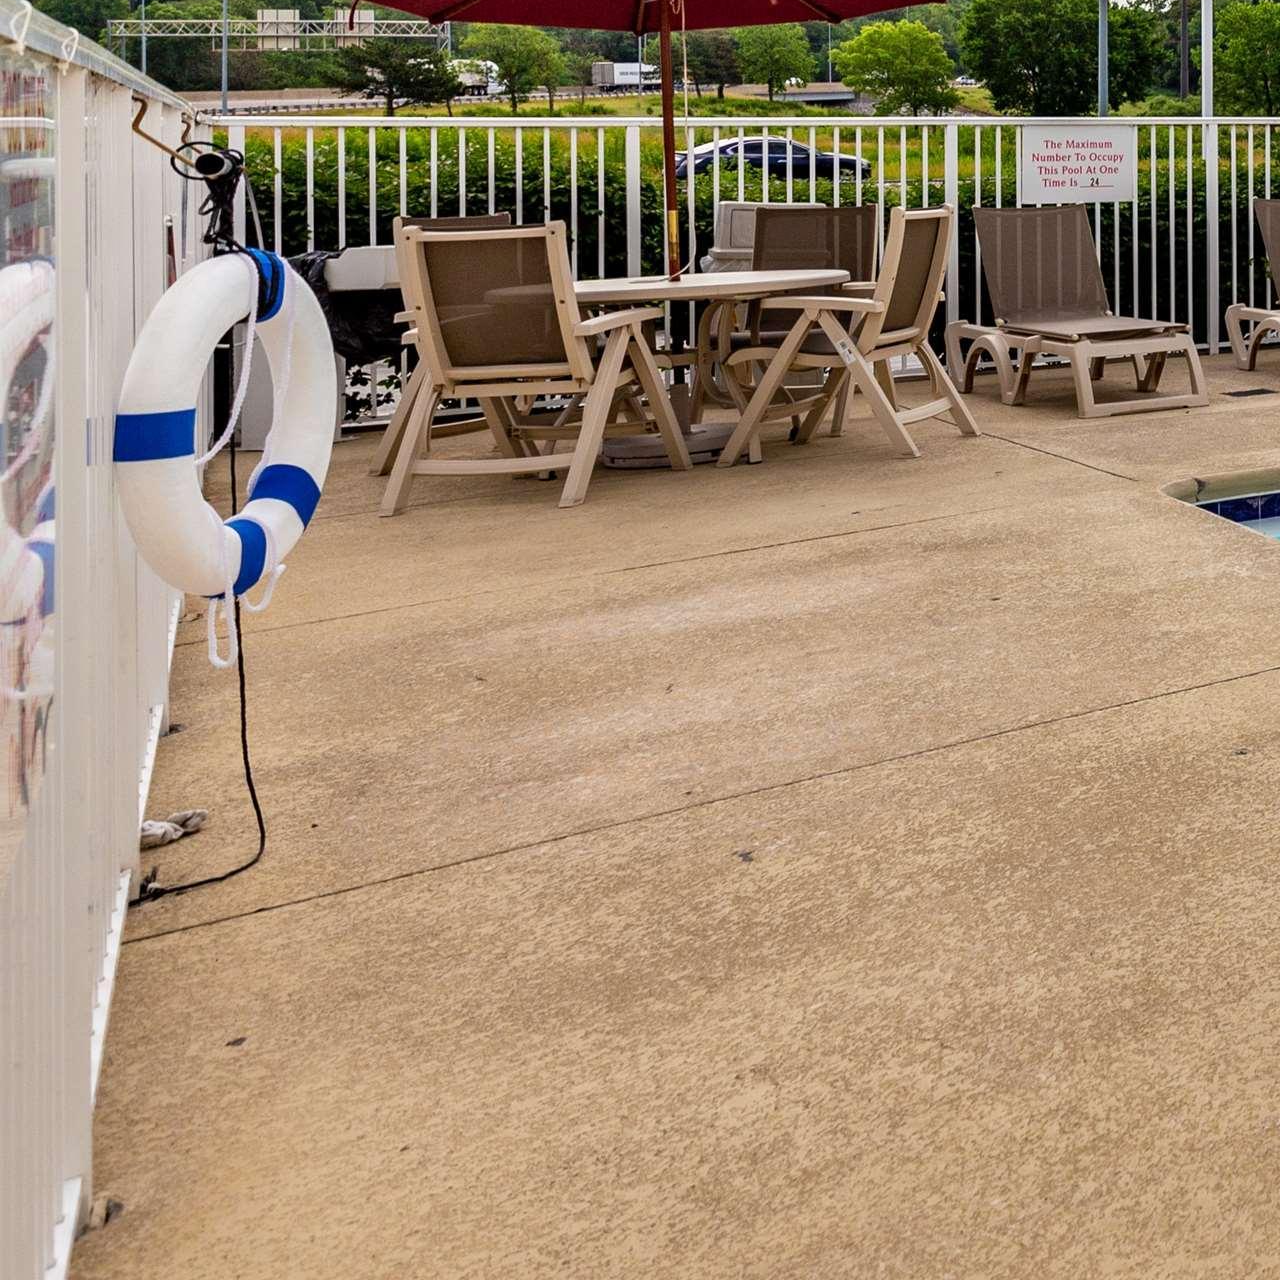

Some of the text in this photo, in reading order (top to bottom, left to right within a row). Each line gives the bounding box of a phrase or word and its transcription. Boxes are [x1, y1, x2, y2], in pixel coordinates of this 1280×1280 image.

[1043, 140, 1113, 149] The Maximum
[1031, 153, 1124, 163] Number To Occupy
[1037, 165, 1119, 175] This Pool At One
[1042, 178, 1099, 188] Time Is 24
